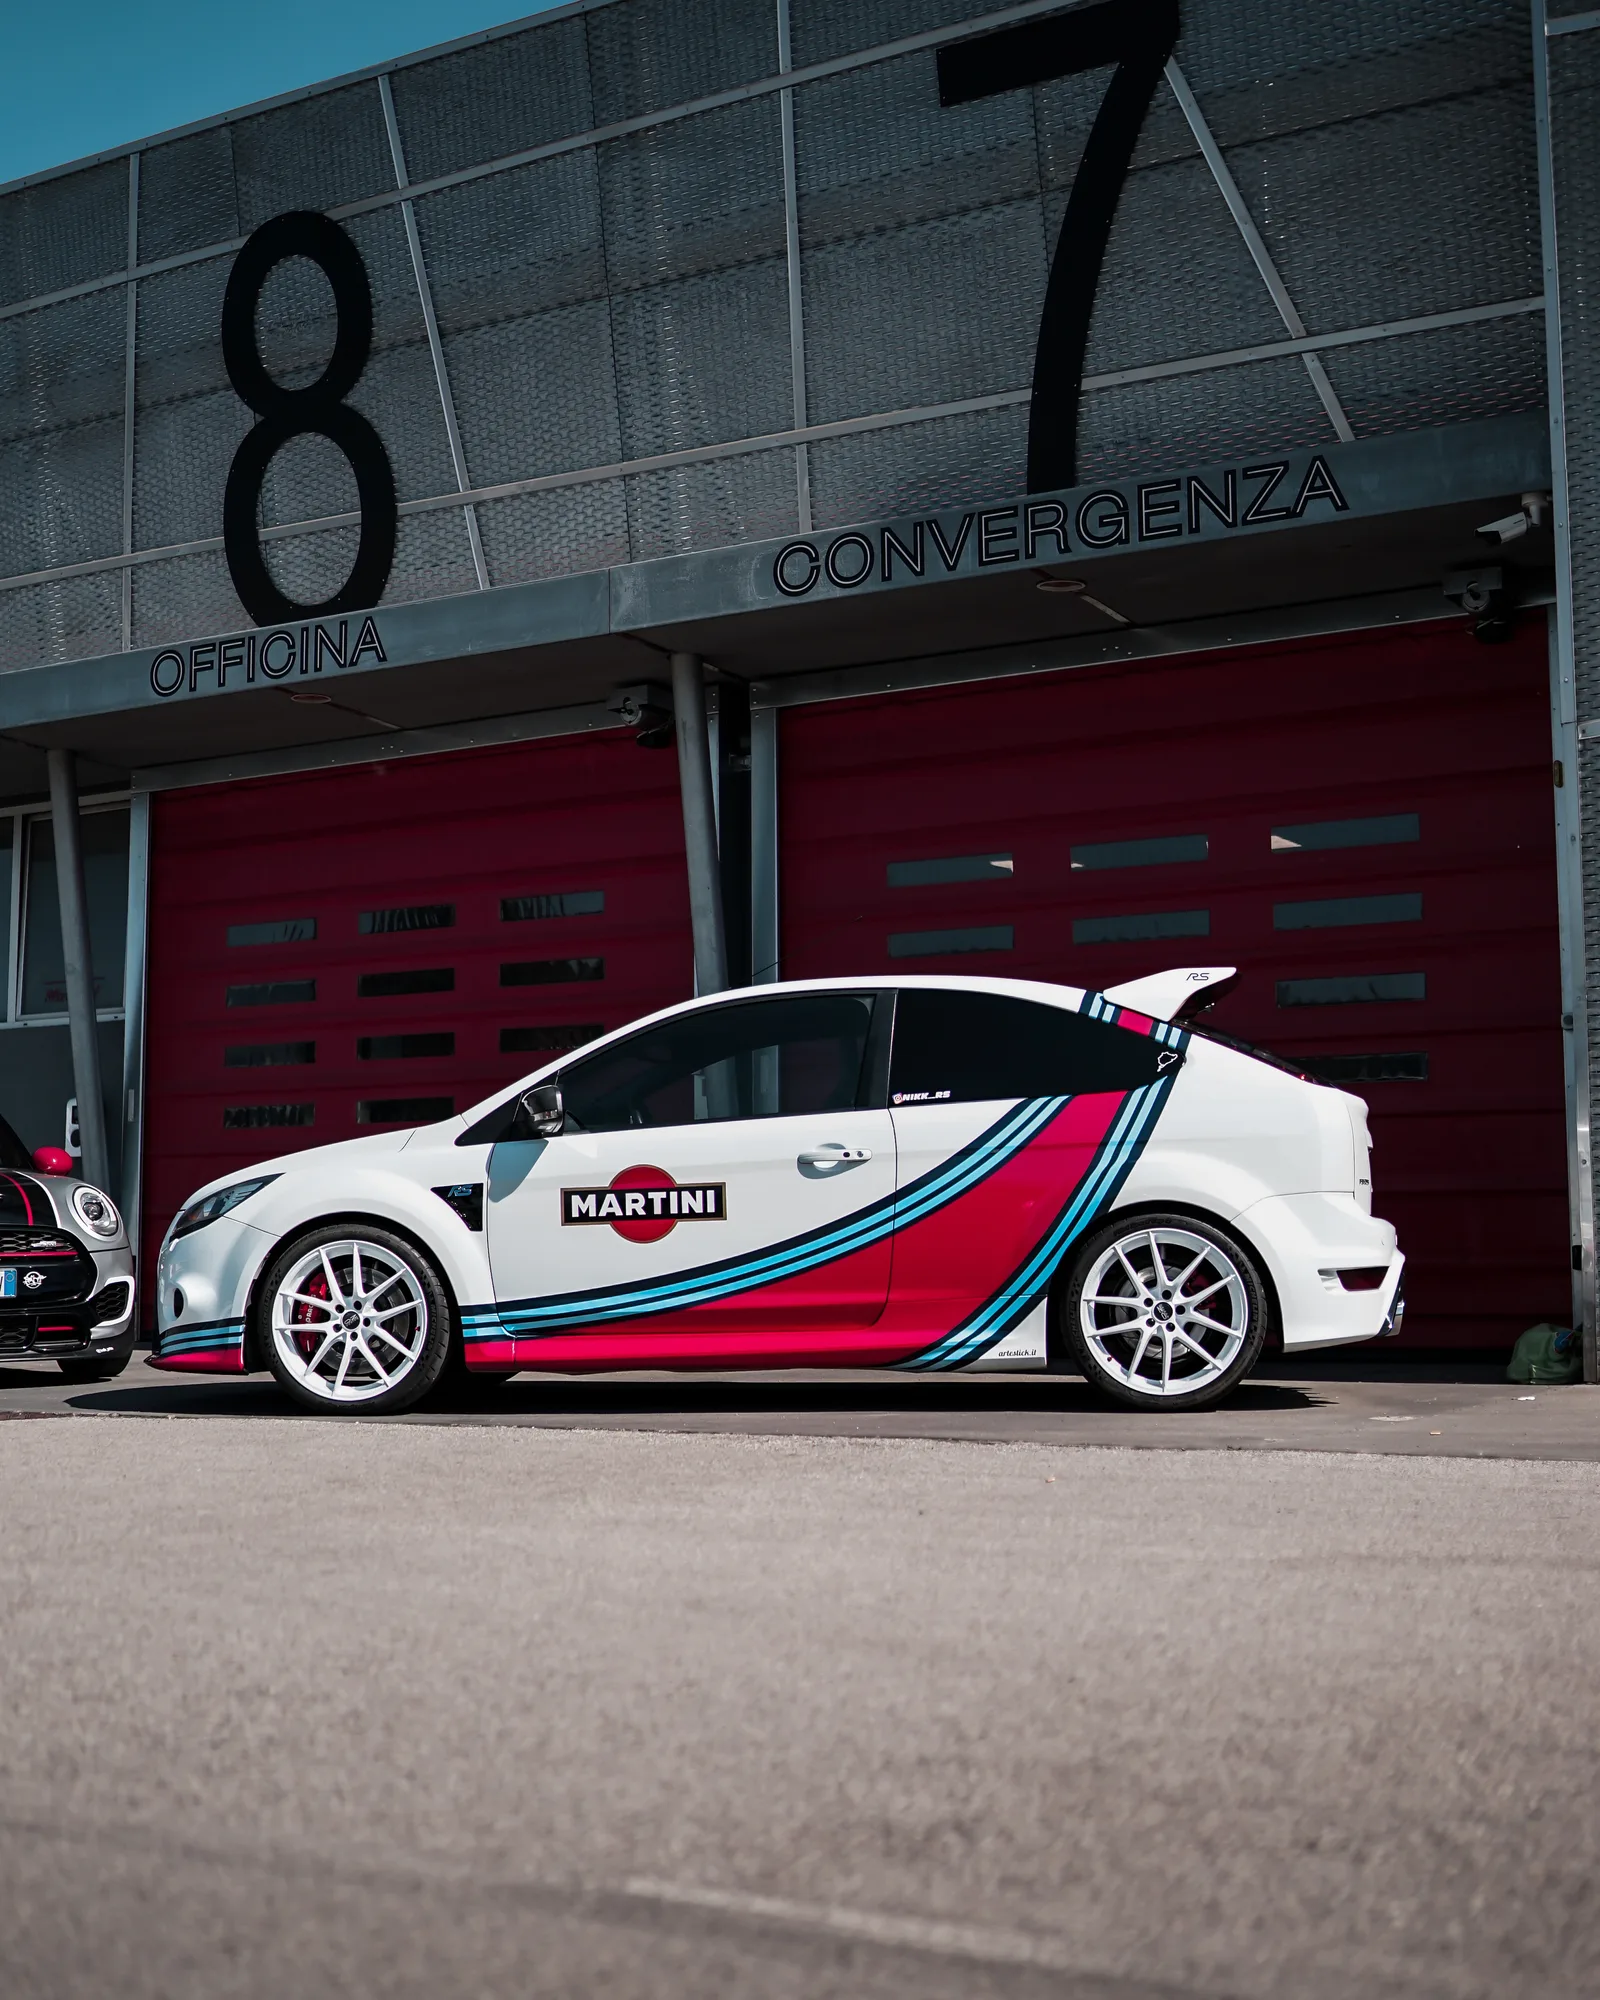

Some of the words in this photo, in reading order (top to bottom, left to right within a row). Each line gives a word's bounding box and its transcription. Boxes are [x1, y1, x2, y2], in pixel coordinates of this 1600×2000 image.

[937, 0, 1181, 495] 7
[222, 210, 398, 628] 8
[774, 454, 1350, 598] CONVERGENZA
[149, 615, 388, 698] OFFICINA
[1186, 972, 1210, 981] RS
[447, 1184, 473, 1197] RS
[571, 1189, 716, 1218] MARTINI
